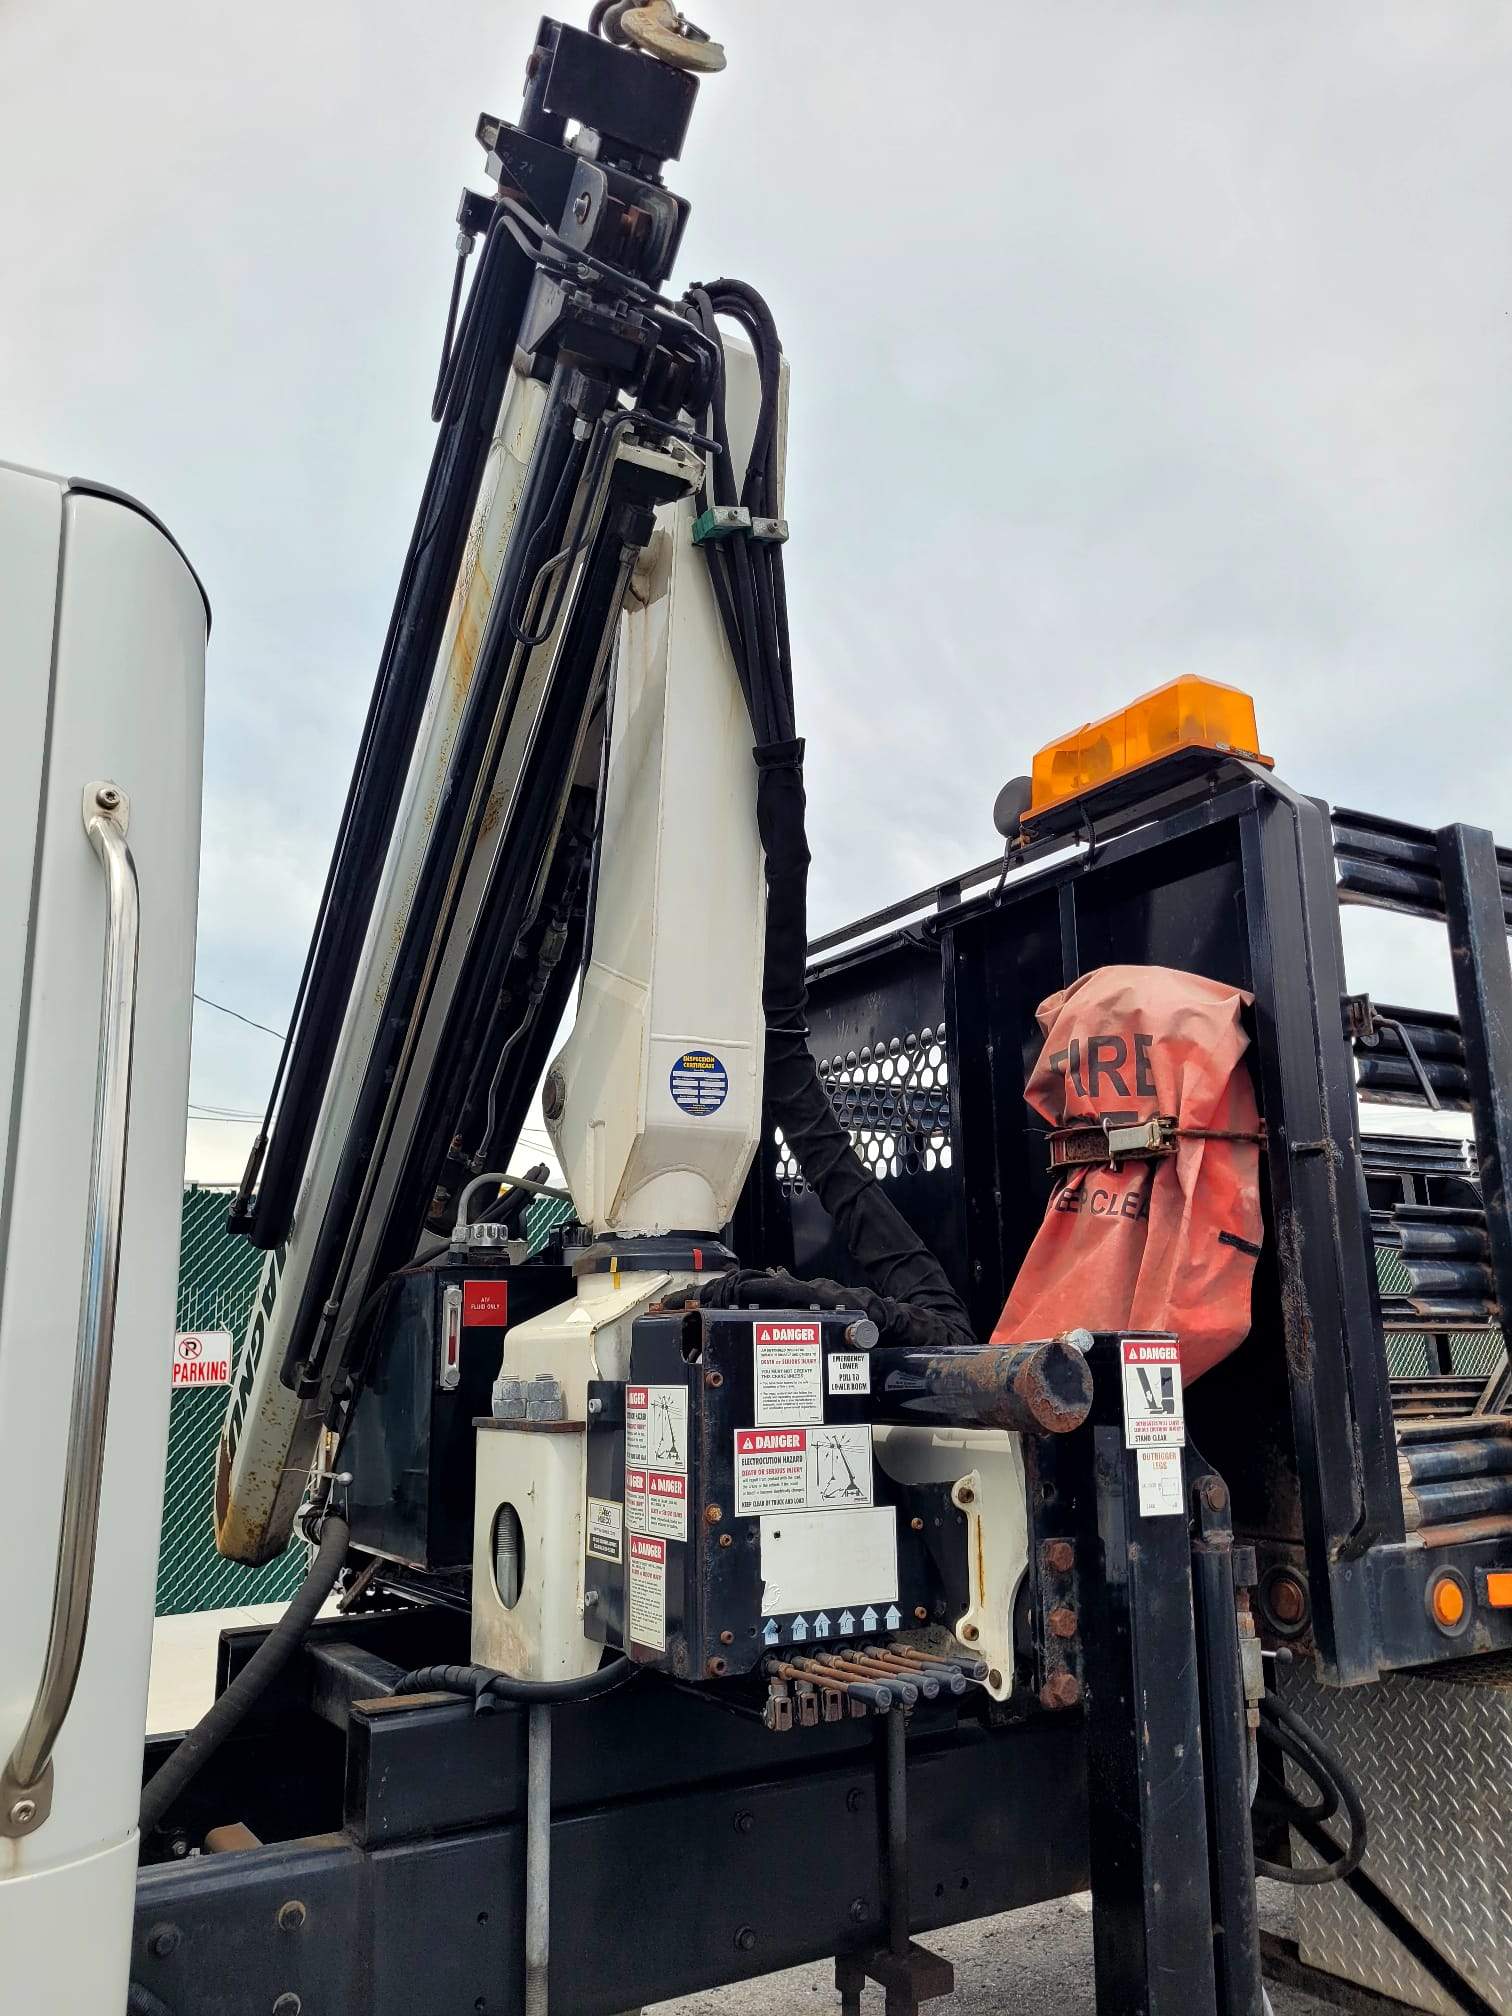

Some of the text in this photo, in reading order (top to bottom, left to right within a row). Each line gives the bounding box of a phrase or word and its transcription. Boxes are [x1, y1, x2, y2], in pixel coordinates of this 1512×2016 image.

[682, 1055, 715, 1063] INSPECTION
[773, 1328, 815, 1341] DANGER
[832, 1355, 864, 1363] EMERGENCY
[1140, 1347, 1178, 1360] DANGER
[173, 1360, 227, 1382] PARKING
[839, 1362, 859, 1370] LOWER
[755, 1434, 801, 1449] DANGER
[1152, 1433, 1167, 1441] CLEAR
[741, 1455, 803, 1466] ELECTROCUTION HAZARD
[1142, 1451, 1177, 1461] OUTRIGGER
[1152, 1461, 1168, 1470] LEGS
[657, 1478, 683, 1494] DANGER
[638, 1541, 662, 1560] DANGER
